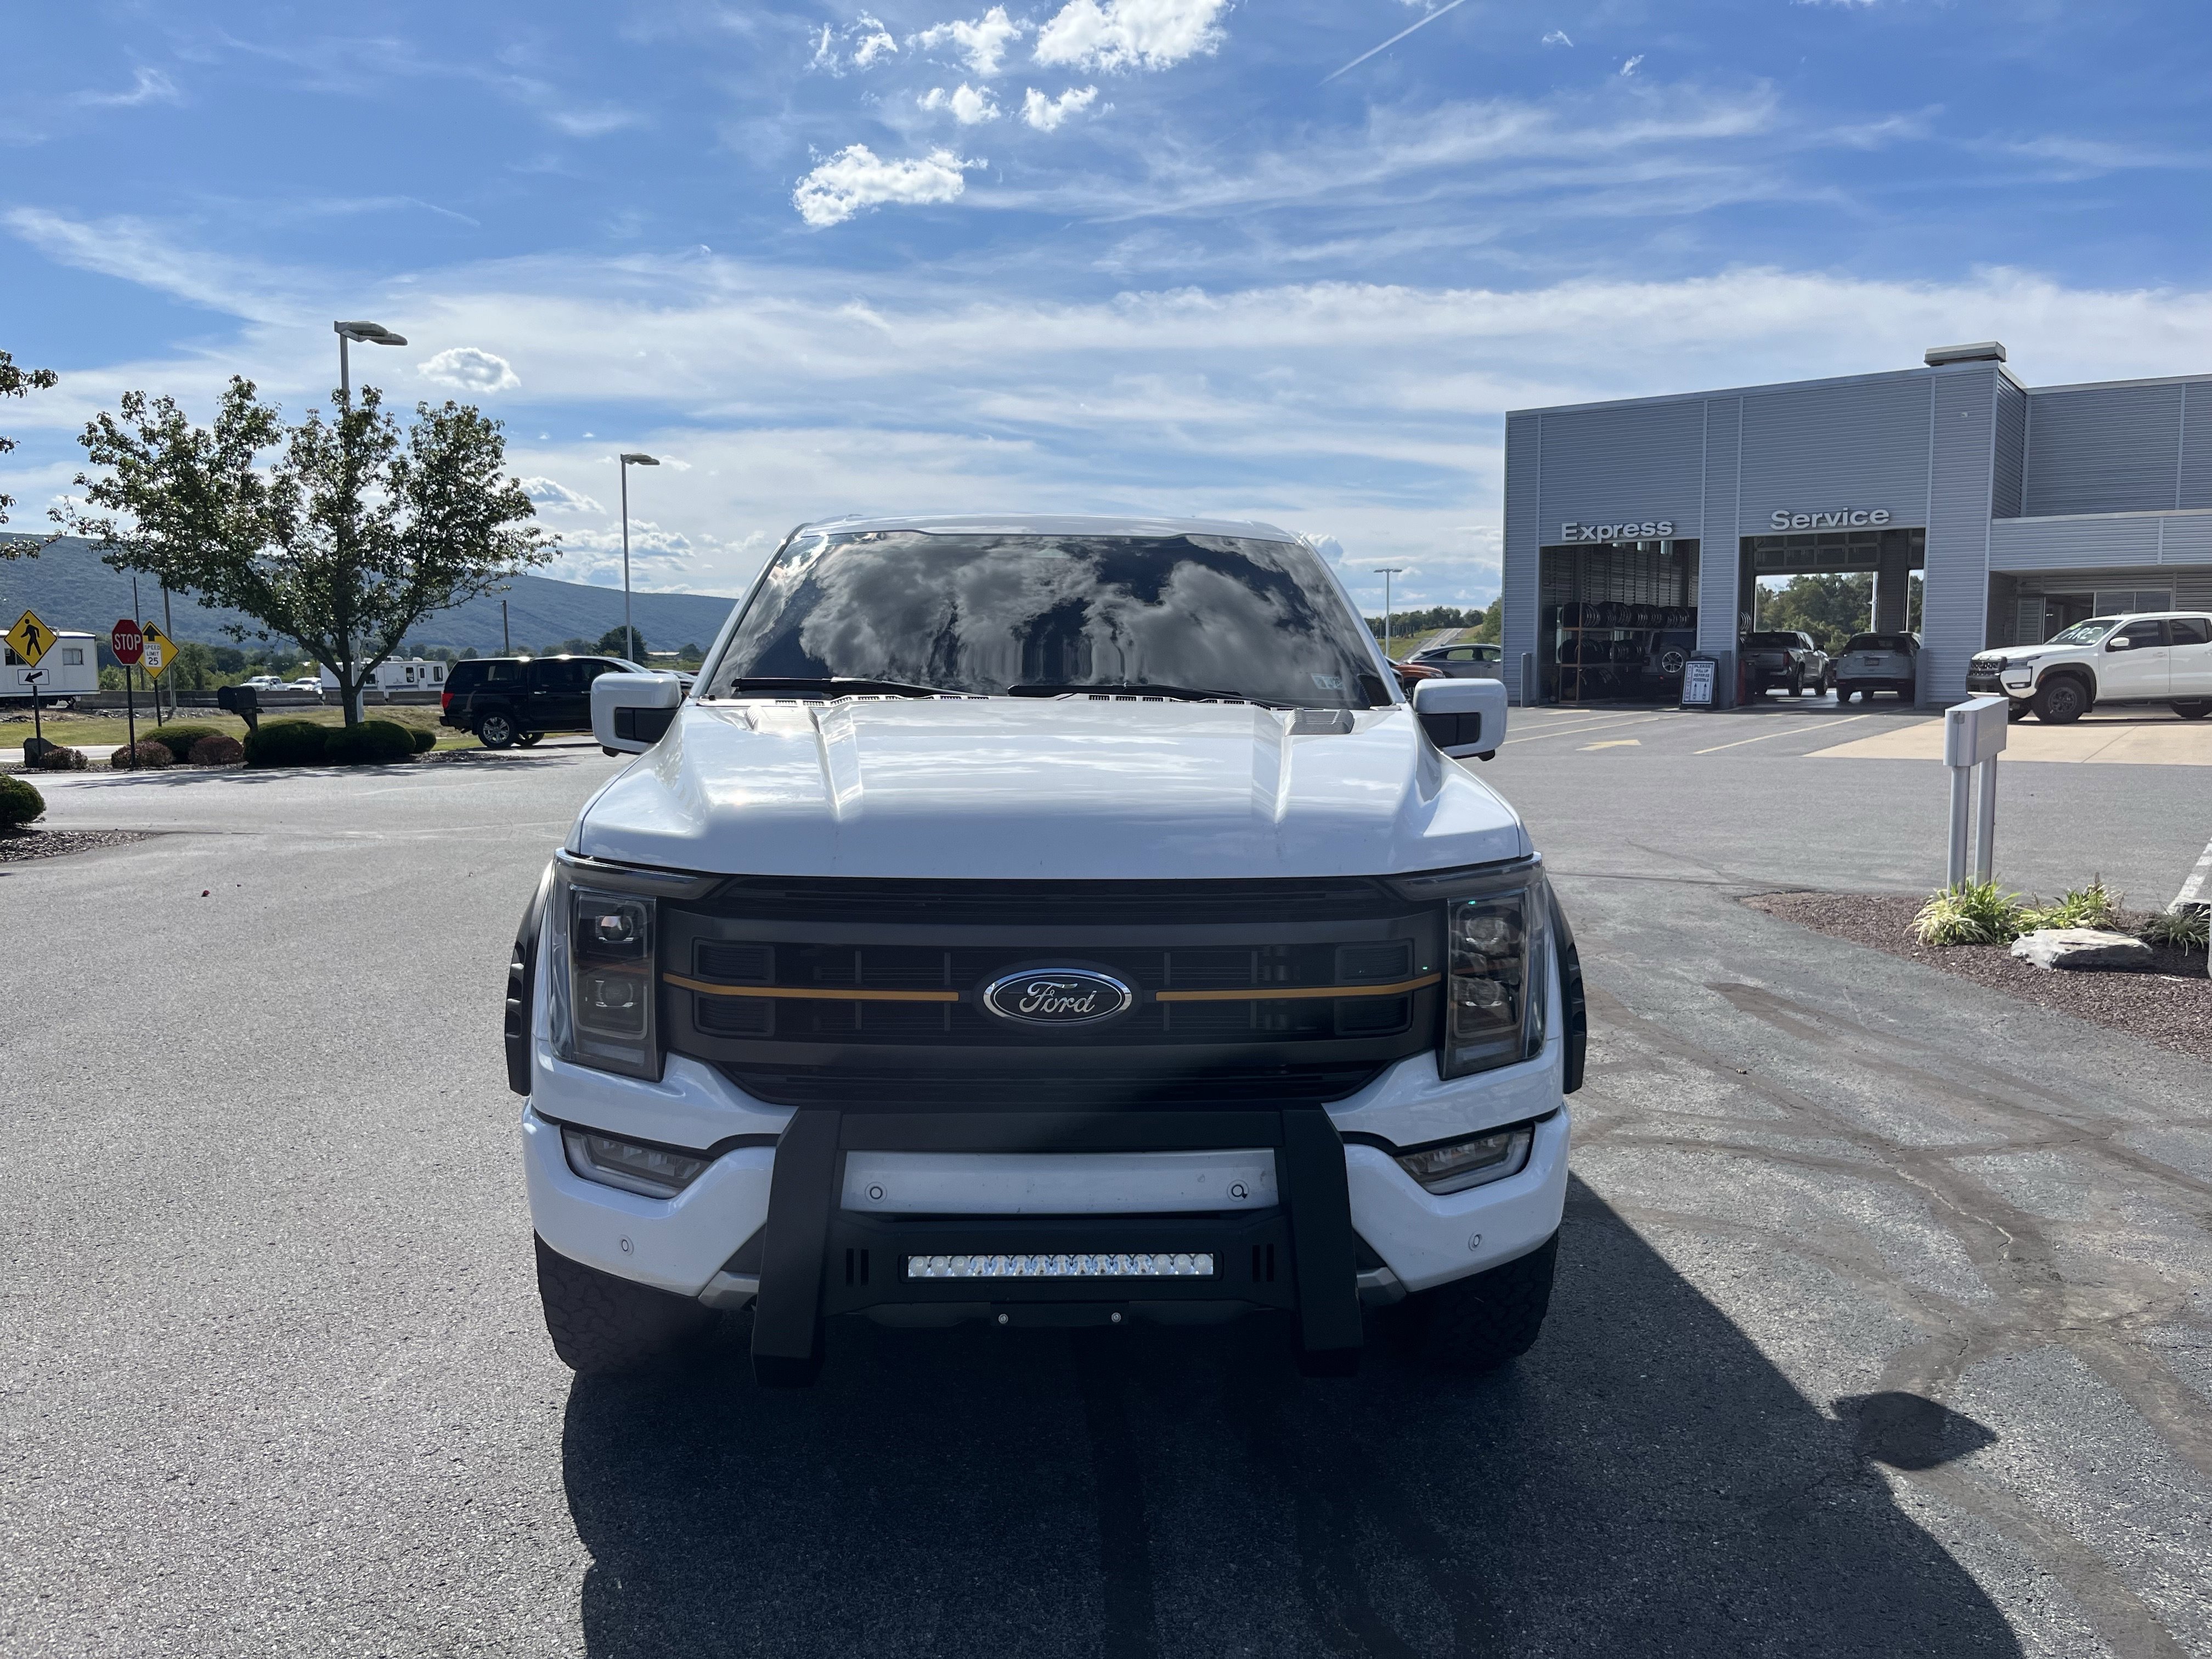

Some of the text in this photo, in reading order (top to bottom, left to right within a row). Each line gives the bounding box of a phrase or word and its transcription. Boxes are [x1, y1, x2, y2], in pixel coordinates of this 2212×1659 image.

[1770, 507, 1889, 530] Service
[1561, 521, 1673, 543] Express
[114, 633, 141, 651] STOP
[148, 657, 159, 665] 25
[1019, 981, 1097, 1013] Ford
